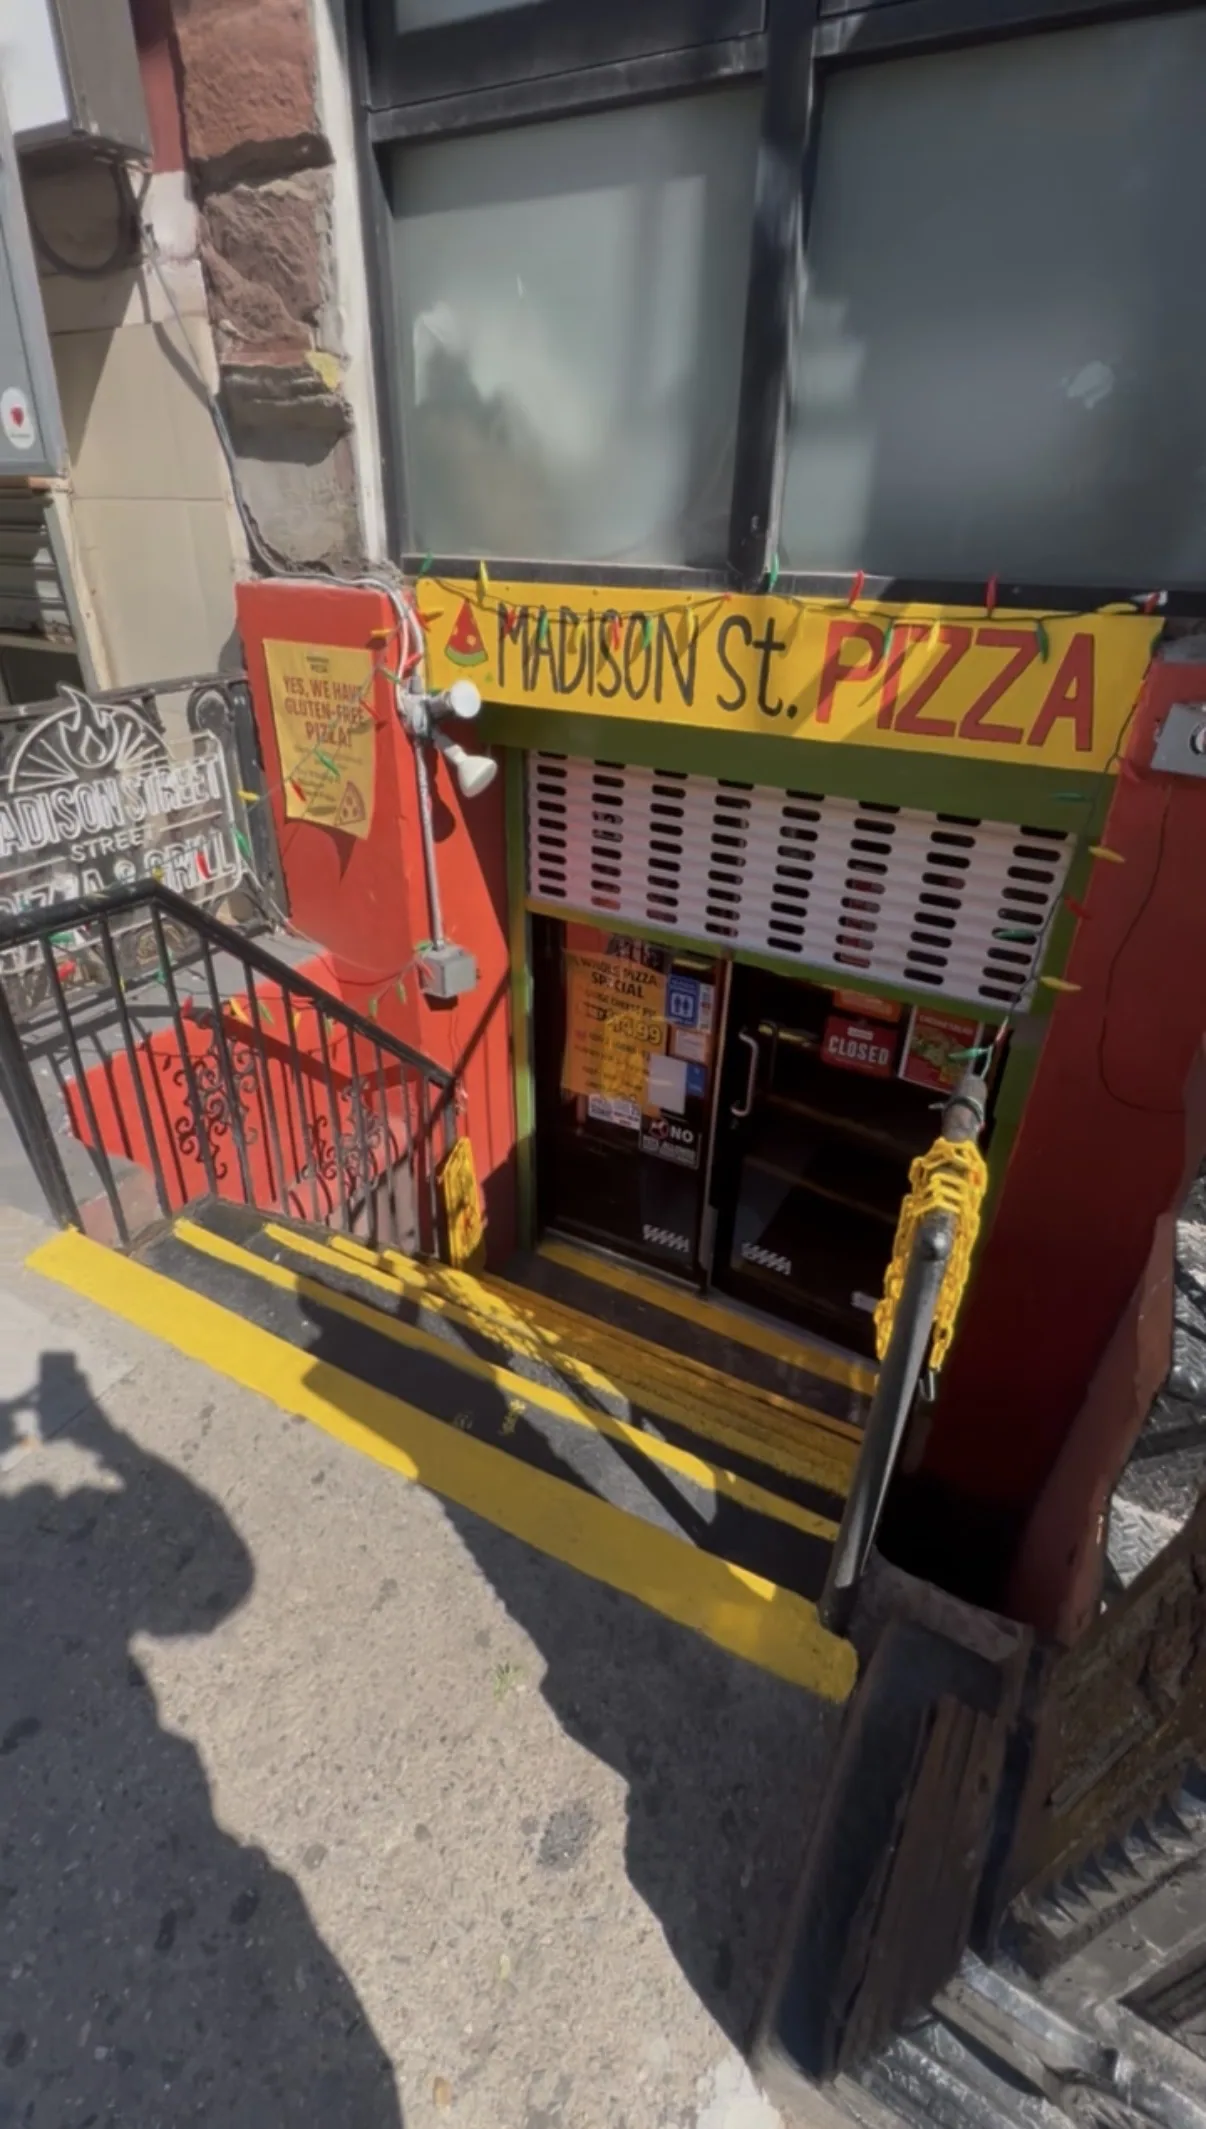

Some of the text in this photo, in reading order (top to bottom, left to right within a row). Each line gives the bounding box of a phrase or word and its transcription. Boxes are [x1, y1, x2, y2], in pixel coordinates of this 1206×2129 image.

[283, 676, 363, 701] YES, WE HAVE
[496, 601, 1095, 752] MADISON St. PIZZA
[284, 698, 365, 726] GLUTEN-FREE
[0, 776, 124, 857] ADISON
[827, 1035, 890, 1066] CLOSED
[669, 1125, 695, 1144] NO
